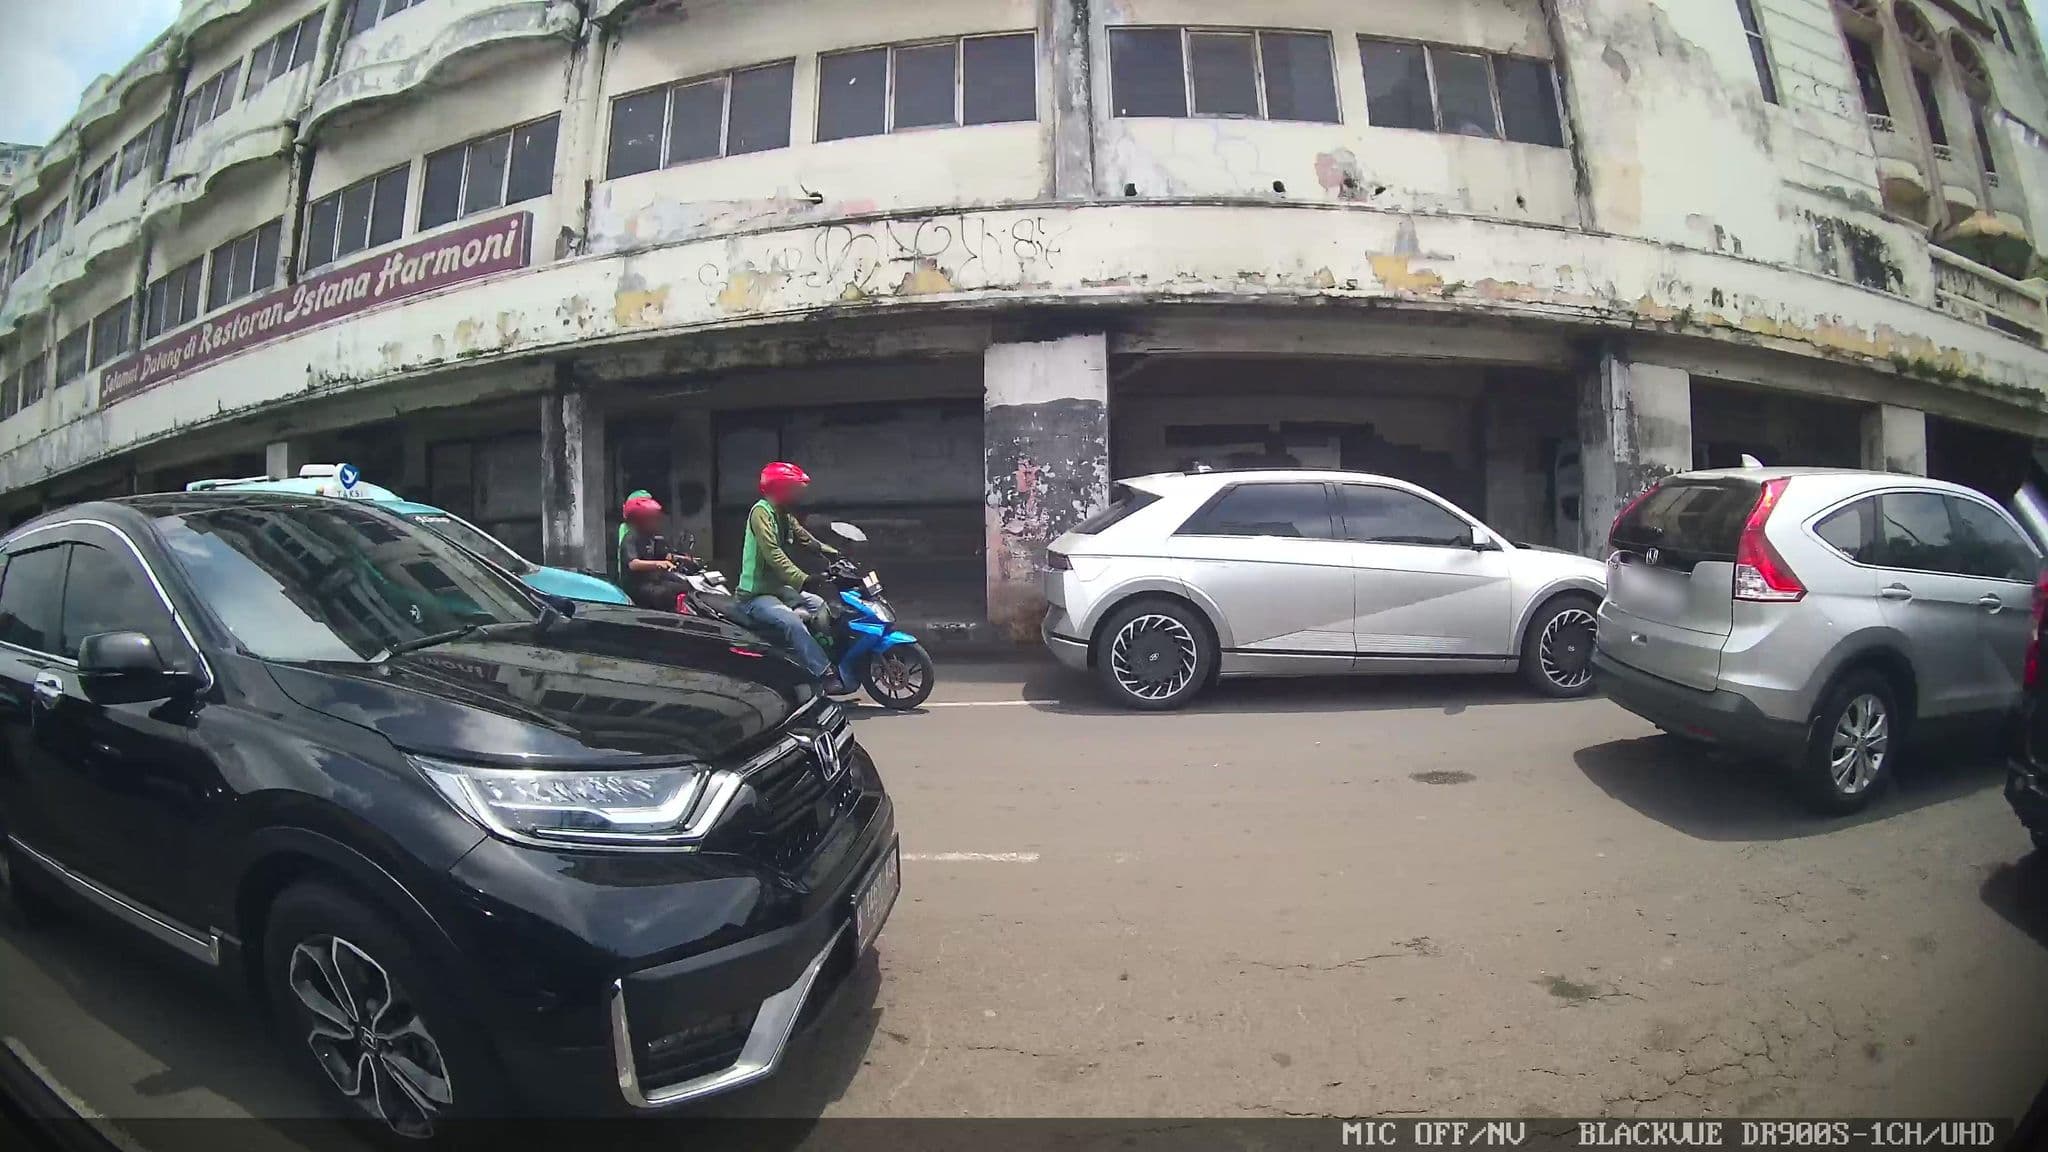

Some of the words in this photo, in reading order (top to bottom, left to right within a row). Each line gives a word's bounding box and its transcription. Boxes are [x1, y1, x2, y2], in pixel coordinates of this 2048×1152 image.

[140, 347, 182, 382] Datang
[183, 334, 198, 361] di
[198, 302, 285, 355] Restoran
[284, 271, 372, 323] Istana
[375, 219, 519, 297] Harmoni
